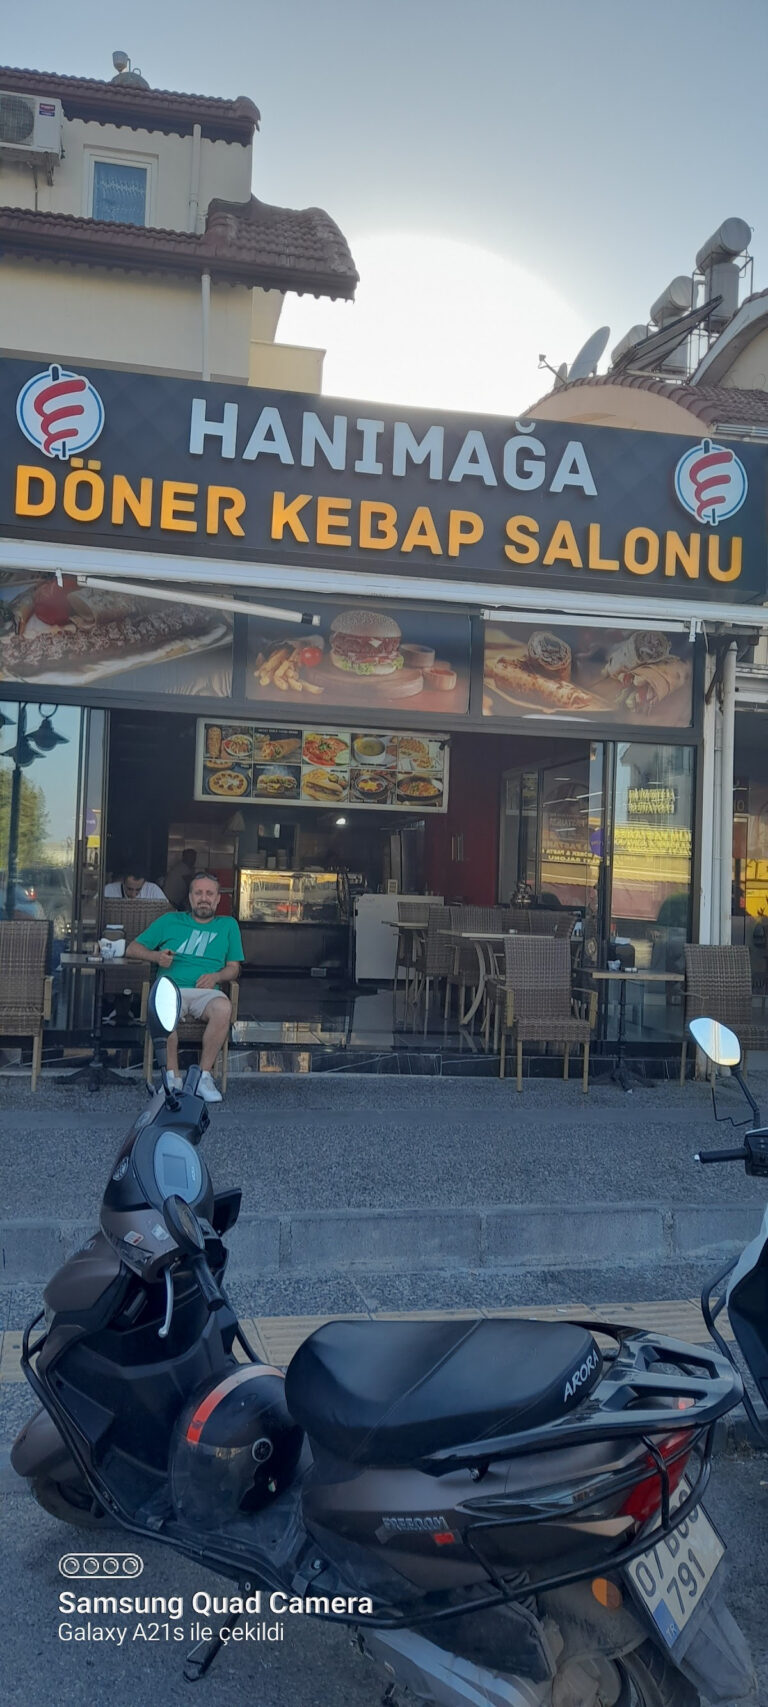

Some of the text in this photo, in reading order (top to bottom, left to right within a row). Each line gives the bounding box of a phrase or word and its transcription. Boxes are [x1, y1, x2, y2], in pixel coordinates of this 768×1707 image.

[189, 398, 598, 497] HANIMAĞA
[14, 458, 743, 583] DÖNER KEBAP SALONU
[563, 1348, 600, 1403] ARORA
[667, 1548, 706, 1615] 791
[665, 1623, 677, 1640] TR
